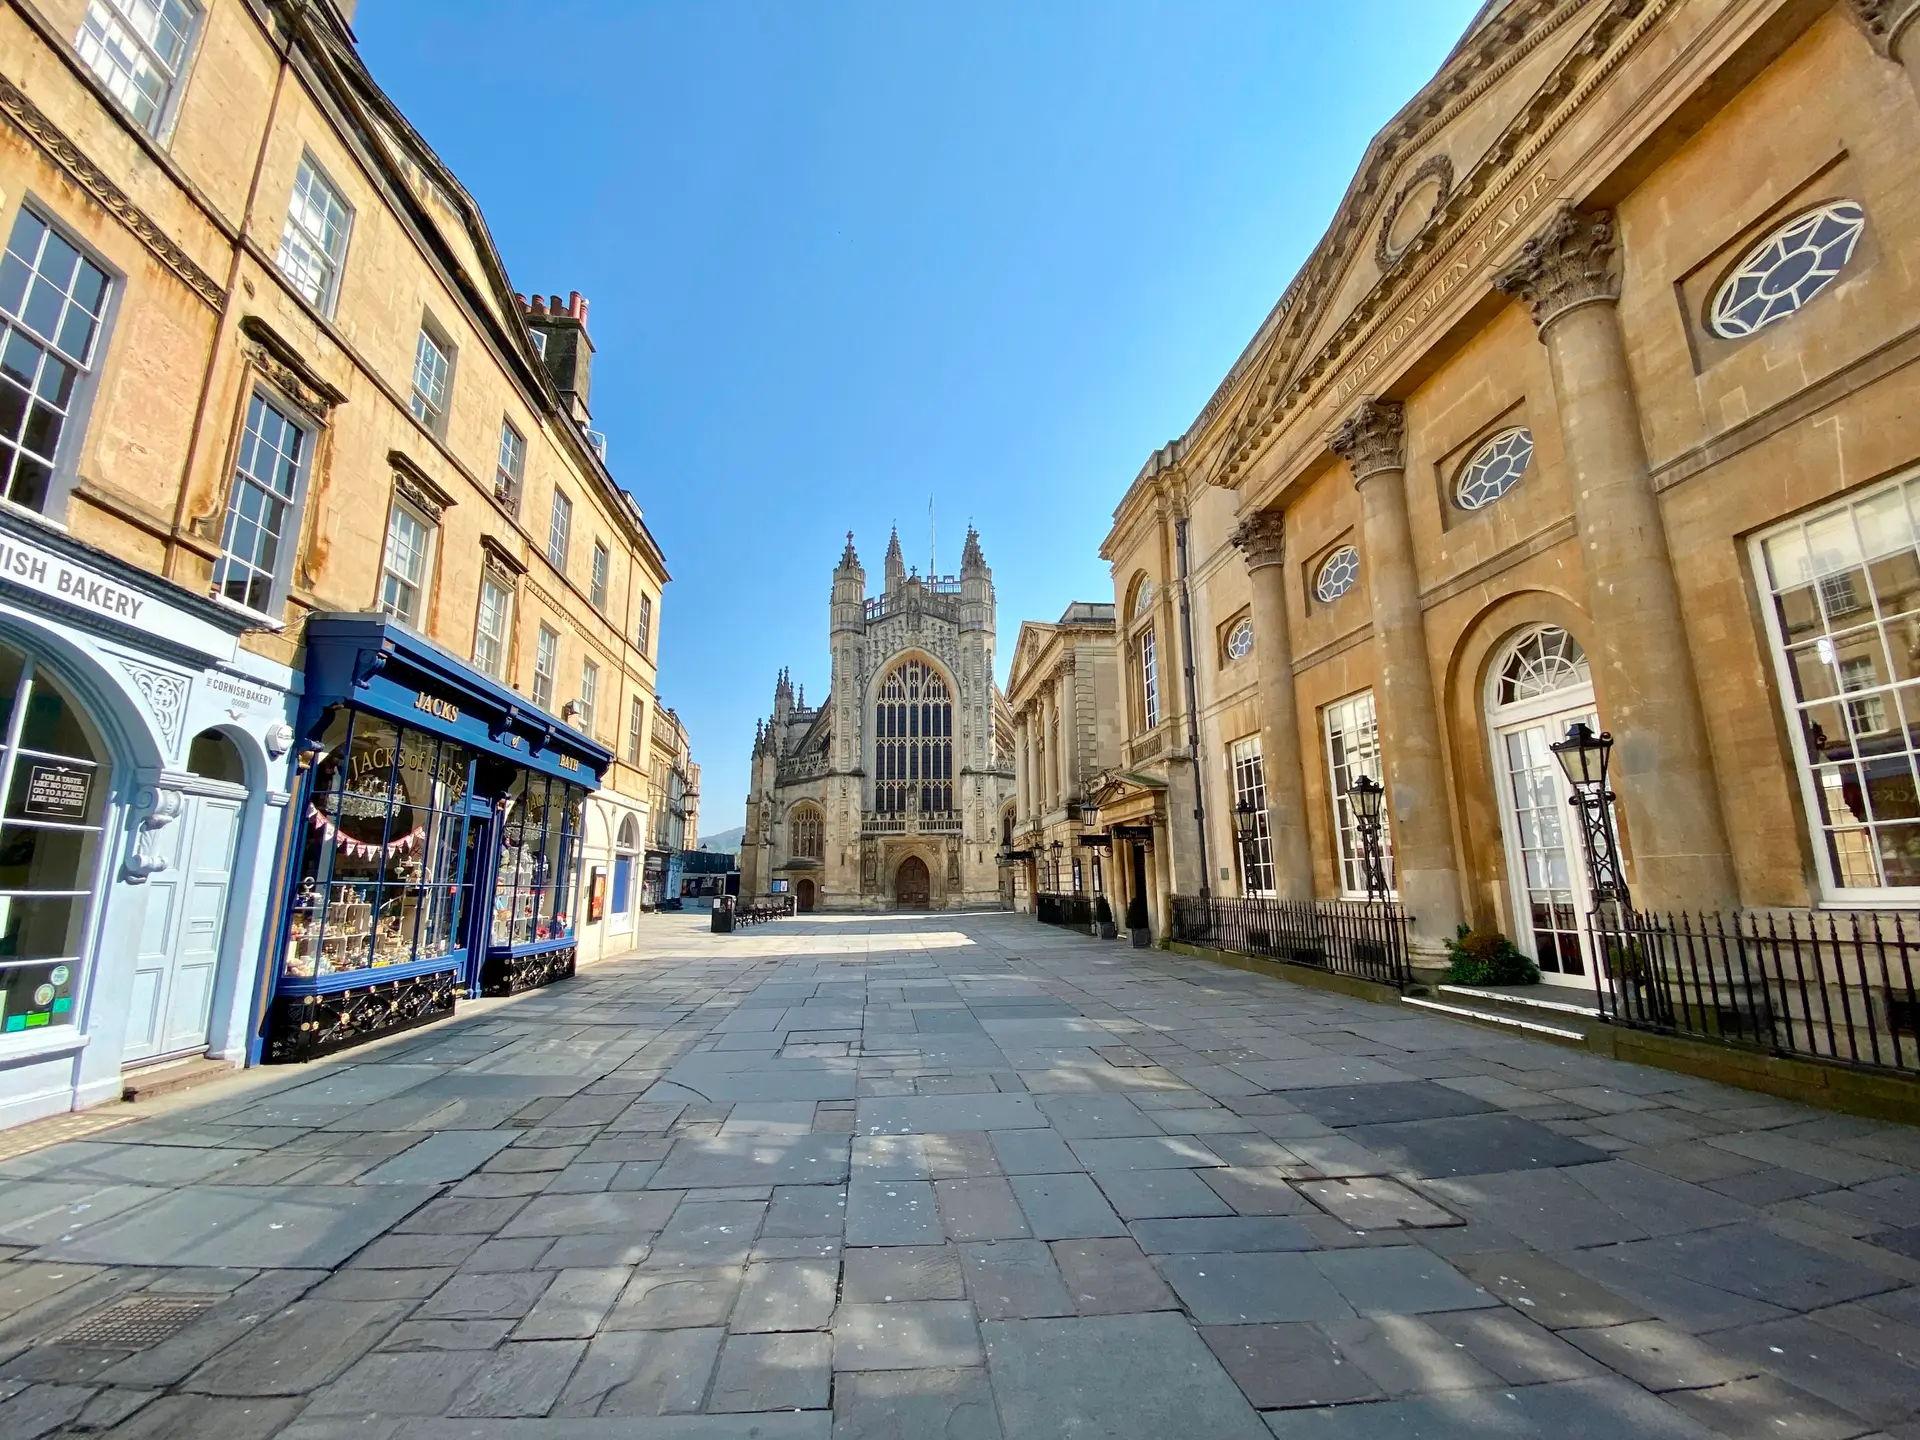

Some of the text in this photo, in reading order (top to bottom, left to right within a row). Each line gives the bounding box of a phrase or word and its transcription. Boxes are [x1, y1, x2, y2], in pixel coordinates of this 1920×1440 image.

[57, 569, 144, 620] BAKERY
[213, 679, 246, 698] CORNISH
[246, 689, 273, 706] BAKERY
[414, 691, 459, 722] JACKS
[559, 753, 579, 773] BATH
[351, 747, 407, 781] JACKS
[33, 780, 50, 788] LIKE
[41, 773, 55, 781] FOR
[61, 776, 82, 785] TASTE
[31, 794, 48, 802] LIKE
[48, 796, 60, 804] NO
